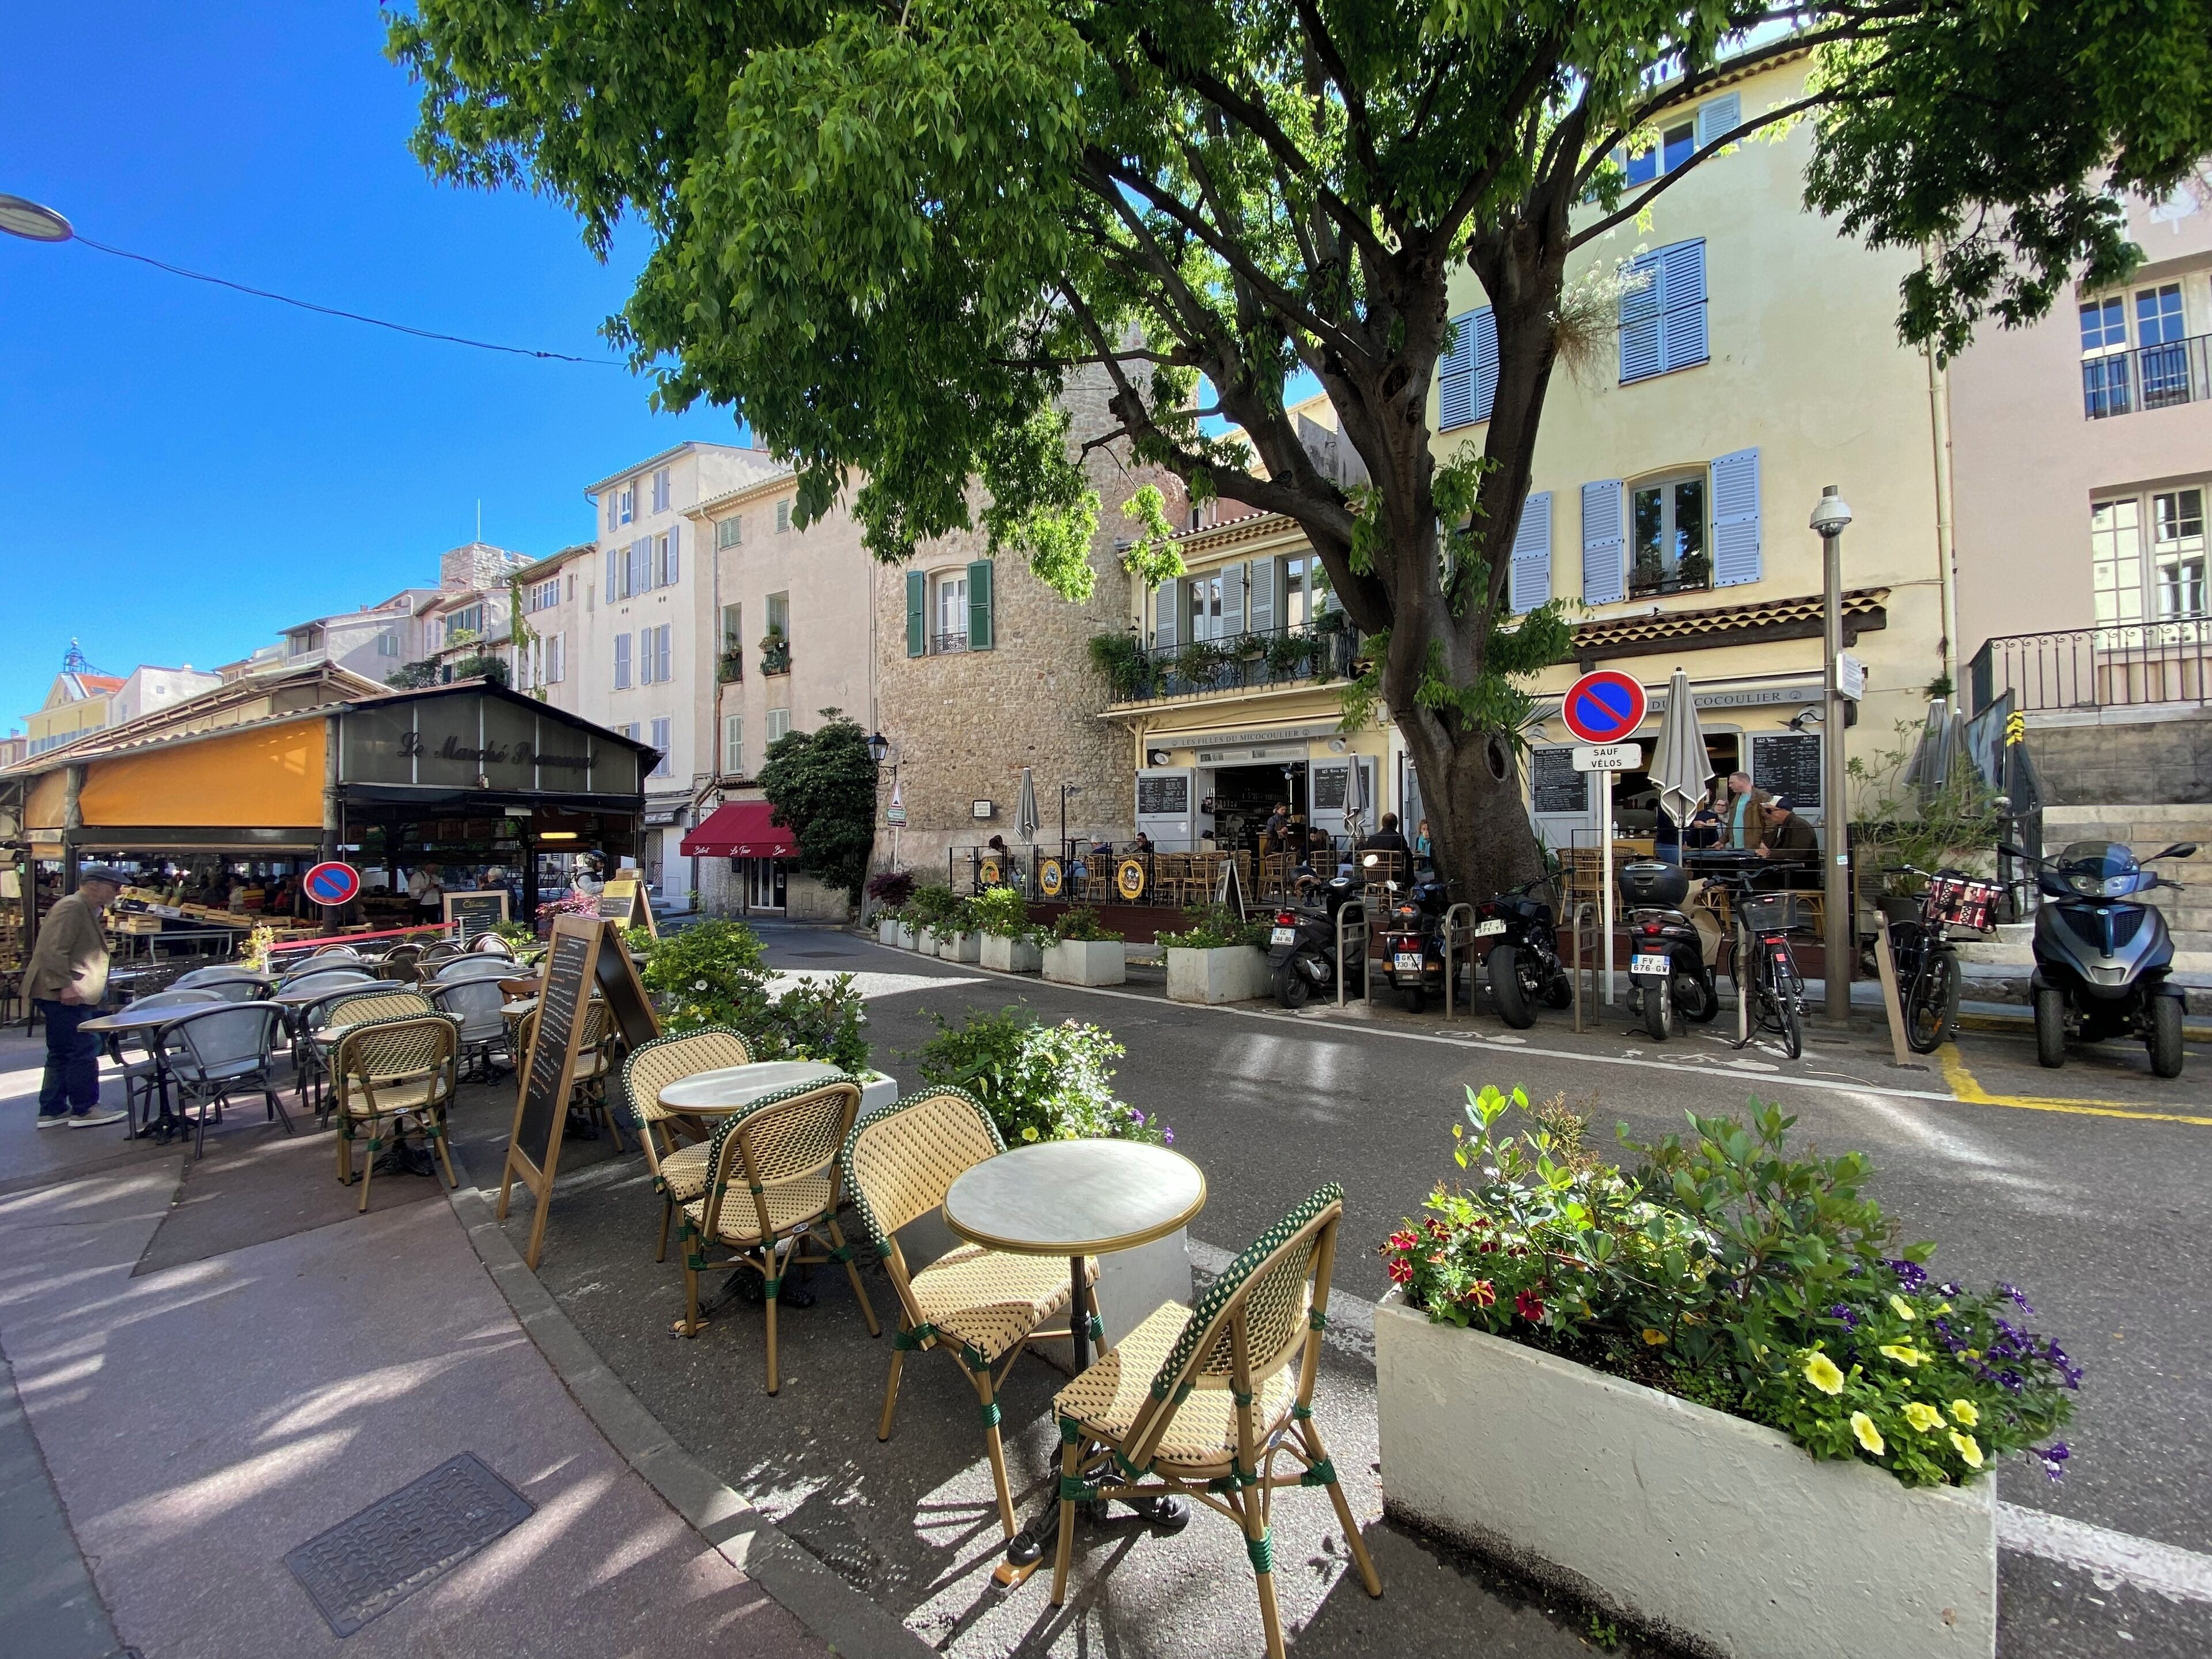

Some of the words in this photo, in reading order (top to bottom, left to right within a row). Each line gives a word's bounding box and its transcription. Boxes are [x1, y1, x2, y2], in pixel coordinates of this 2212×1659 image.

[1694, 692, 1781, 707] COCOULIER
[1240, 730, 1298, 741] MICOCOULIER
[397, 732, 424, 757] Le
[434, 735, 507, 763] Marché
[1591, 759, 1622, 767] VÉLOS
[730, 846, 738, 856] La
[772, 845, 786, 856] Bar
[1634, 964, 1668, 972] 676-GW
